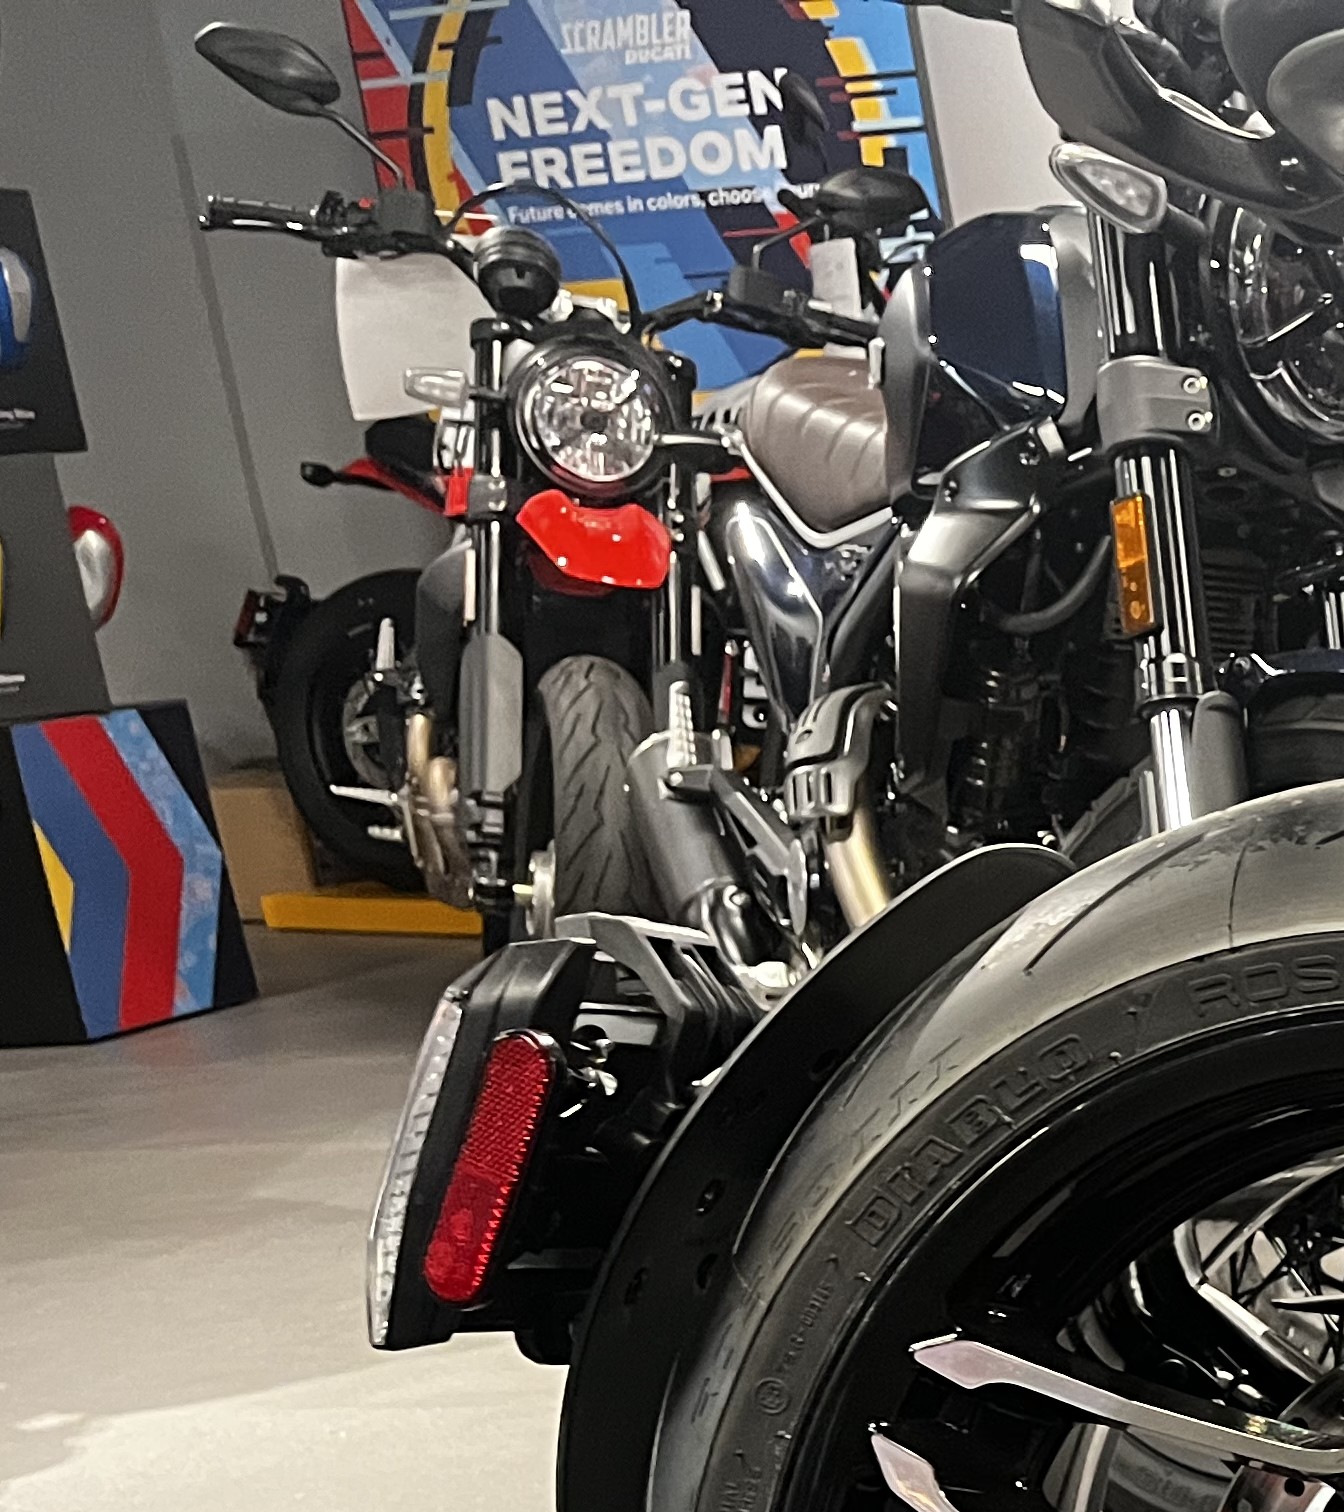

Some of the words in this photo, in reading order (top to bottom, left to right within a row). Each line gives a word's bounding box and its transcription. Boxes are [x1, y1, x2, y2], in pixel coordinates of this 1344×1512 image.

[561, 9, 692, 54] SCRAMBLER
[624, 47, 693, 66] DUCATI
[486, 66, 789, 142] NEXT-GEN
[496, 124, 788, 189] FREEDOM
[507, 205, 565, 224] Future
[626, 194, 644, 213] in
[846, 1034, 1093, 1249] DIABLO
